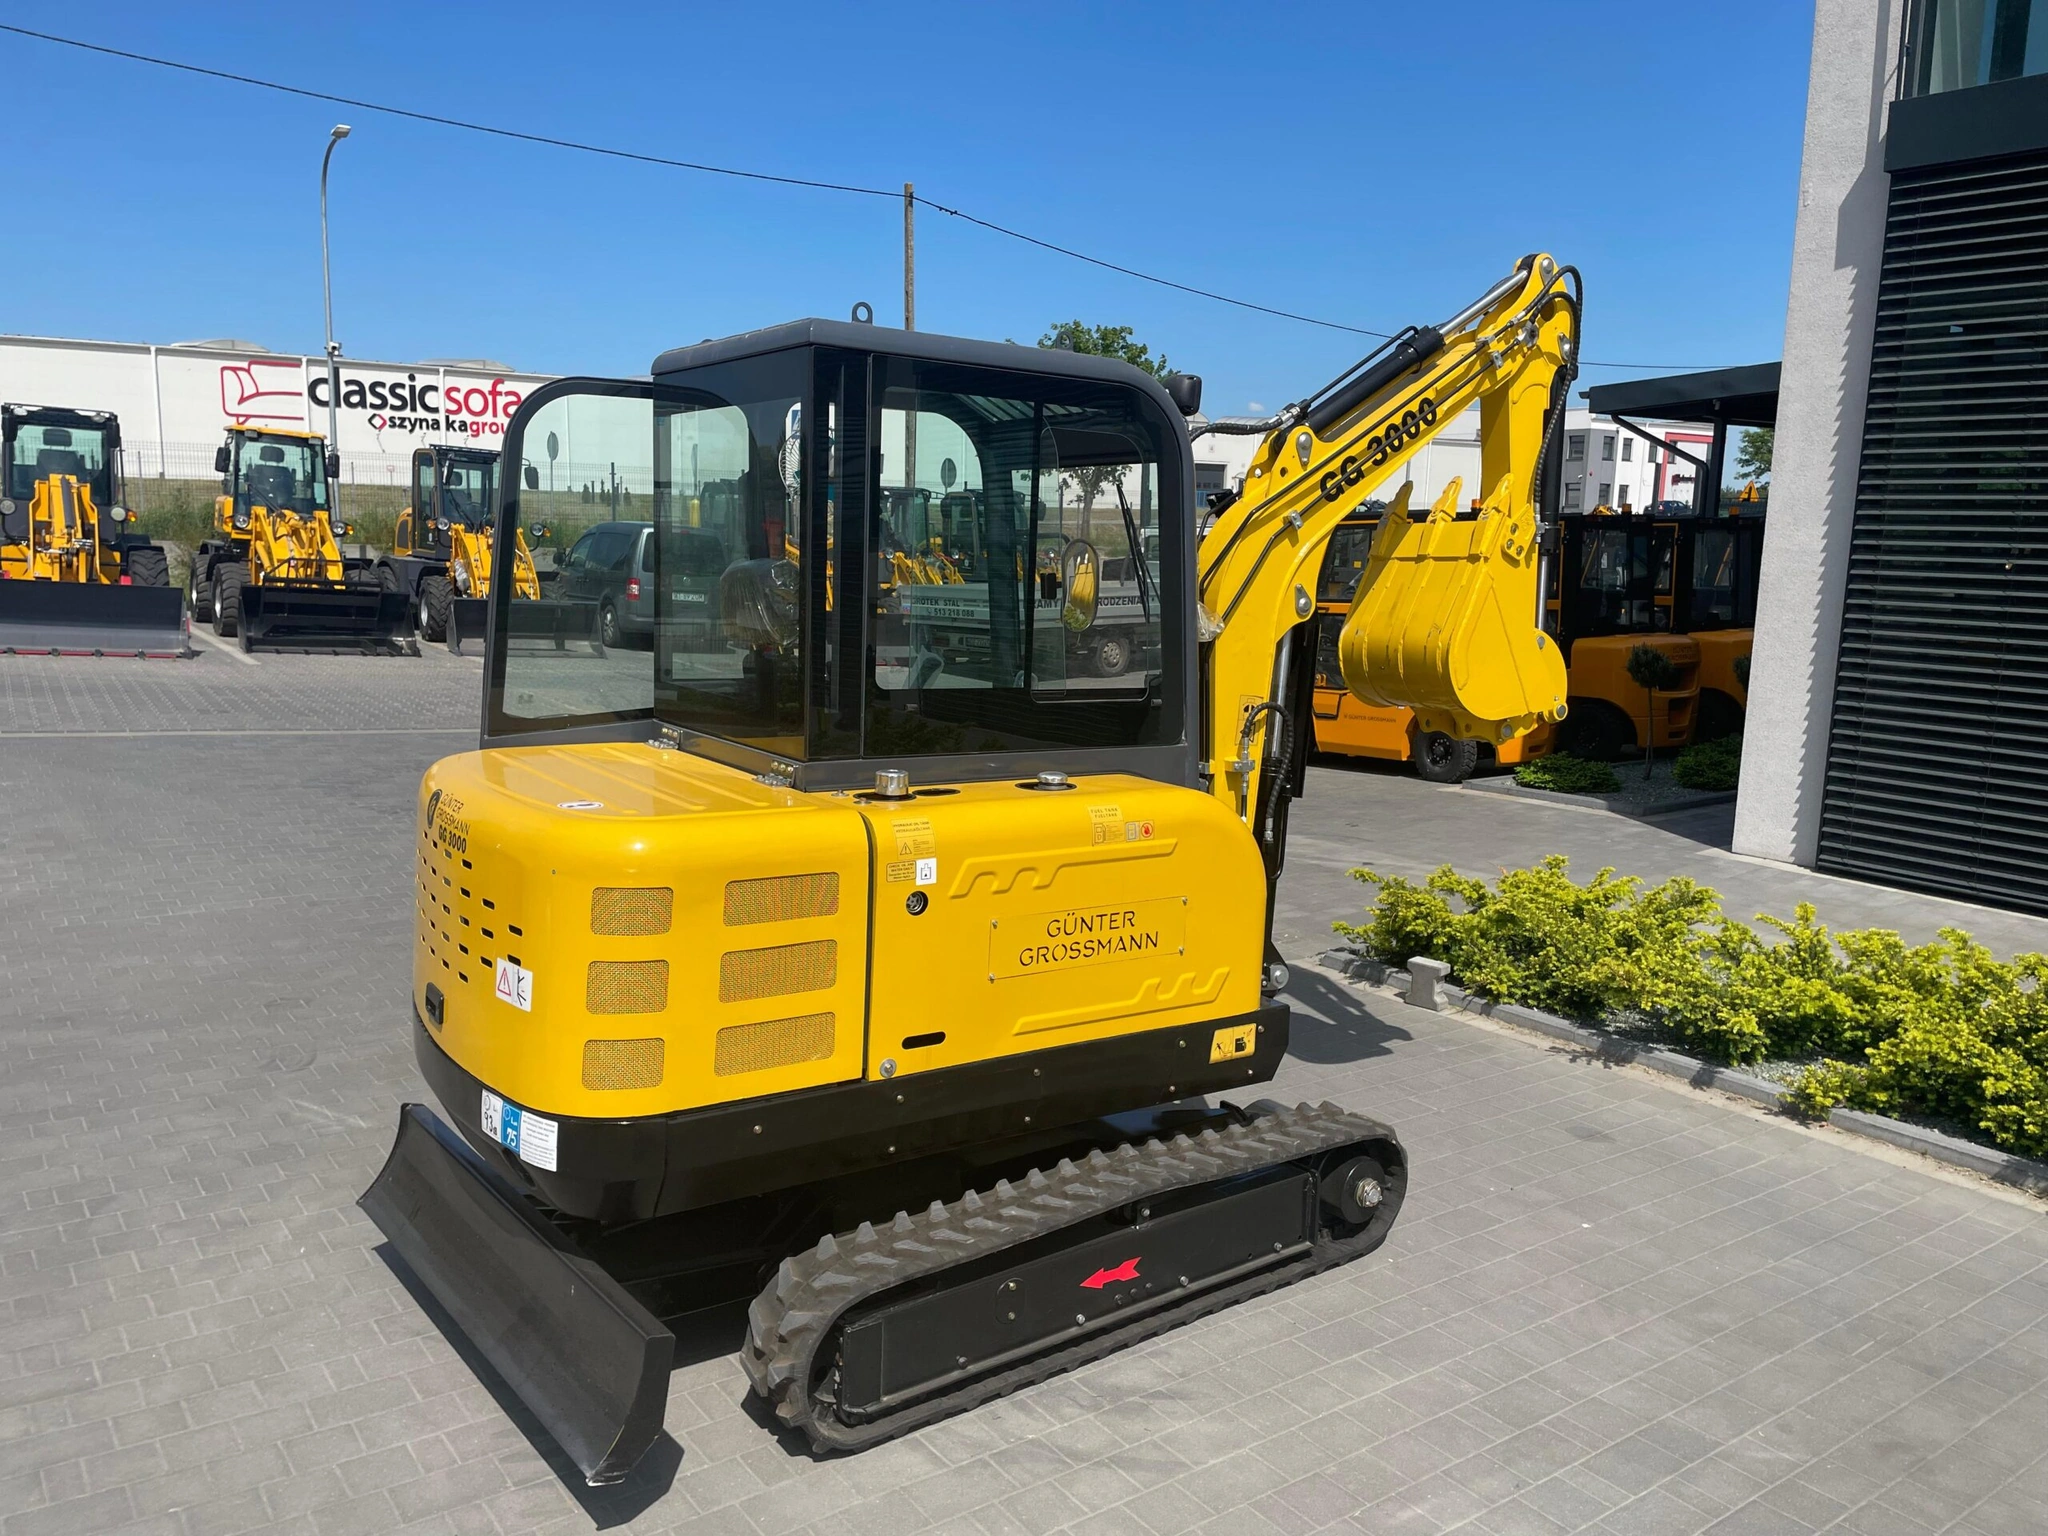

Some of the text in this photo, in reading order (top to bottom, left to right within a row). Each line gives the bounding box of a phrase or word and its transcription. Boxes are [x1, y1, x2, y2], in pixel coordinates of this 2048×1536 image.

[1320, 397, 1437, 502] GG 3000
[934, 608, 946, 616] 513
[948, 609, 960, 617] 218
[943, 599, 960, 607] STAL
[1034, 596, 1142, 609] AMY RODZENIA
[436, 807, 470, 836] GROSSMANN
[439, 824, 467, 854] GG 3000
[1046, 910, 1136, 938] GÜNTER
[1019, 931, 1159, 967] GROSSMANN
[506, 1127, 518, 1147] 75
